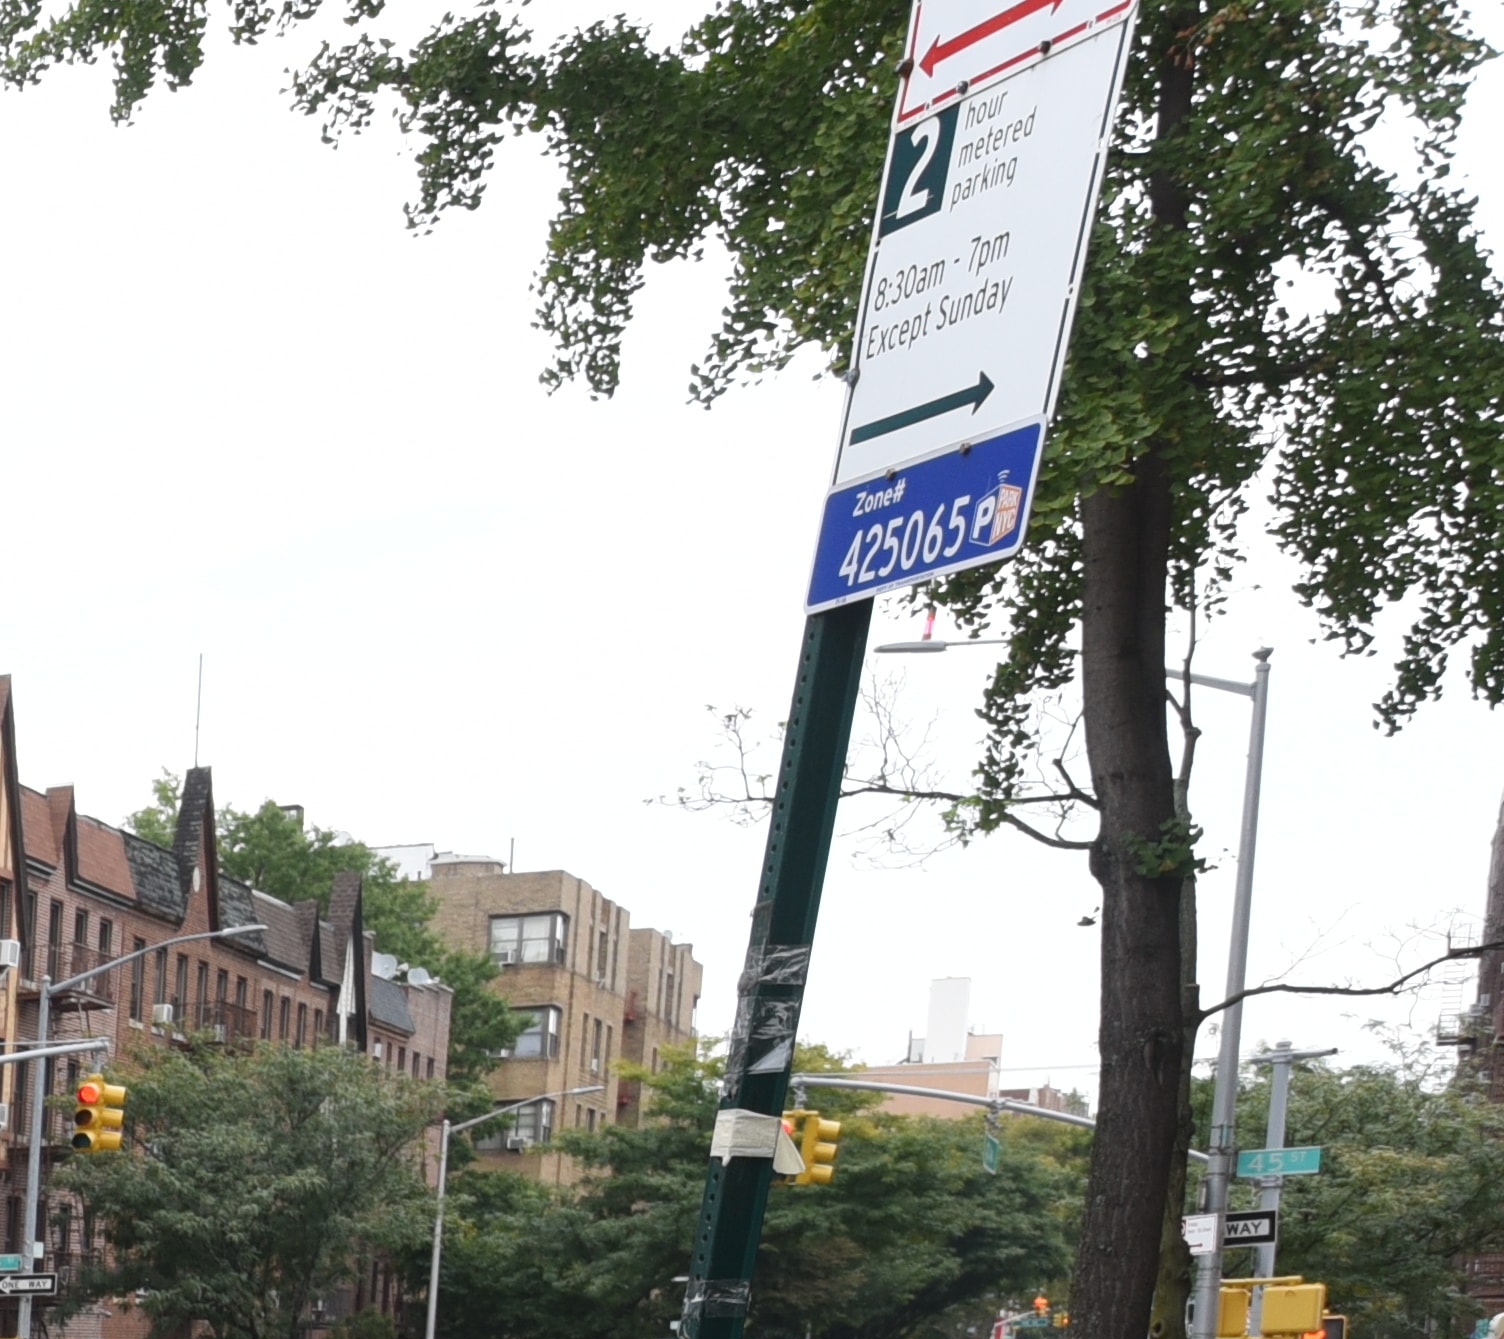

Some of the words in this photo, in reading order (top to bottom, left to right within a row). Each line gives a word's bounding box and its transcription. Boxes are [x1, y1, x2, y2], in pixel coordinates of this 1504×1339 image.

[958, 105, 1037, 168] metered
[964, 91, 1008, 130] hour
[896, 115, 942, 220] 2
[950, 156, 1018, 214] parking
[874, 258, 946, 313] 8:30am
[968, 231, 1011, 277] 7pm
[866, 307, 932, 360] Except
[936, 276, 1014, 331] Sunday
[852, 478, 906, 518] Zone#
[838, 495, 971, 587] 425065
[1248, 1153, 1284, 1172] 45
[1291, 1152, 1307, 1162] ST
[1226, 1221, 1262, 1236] WAY
[2, 1280, 19, 1289] ONE
[28, 1279, 48, 1288] WAY
